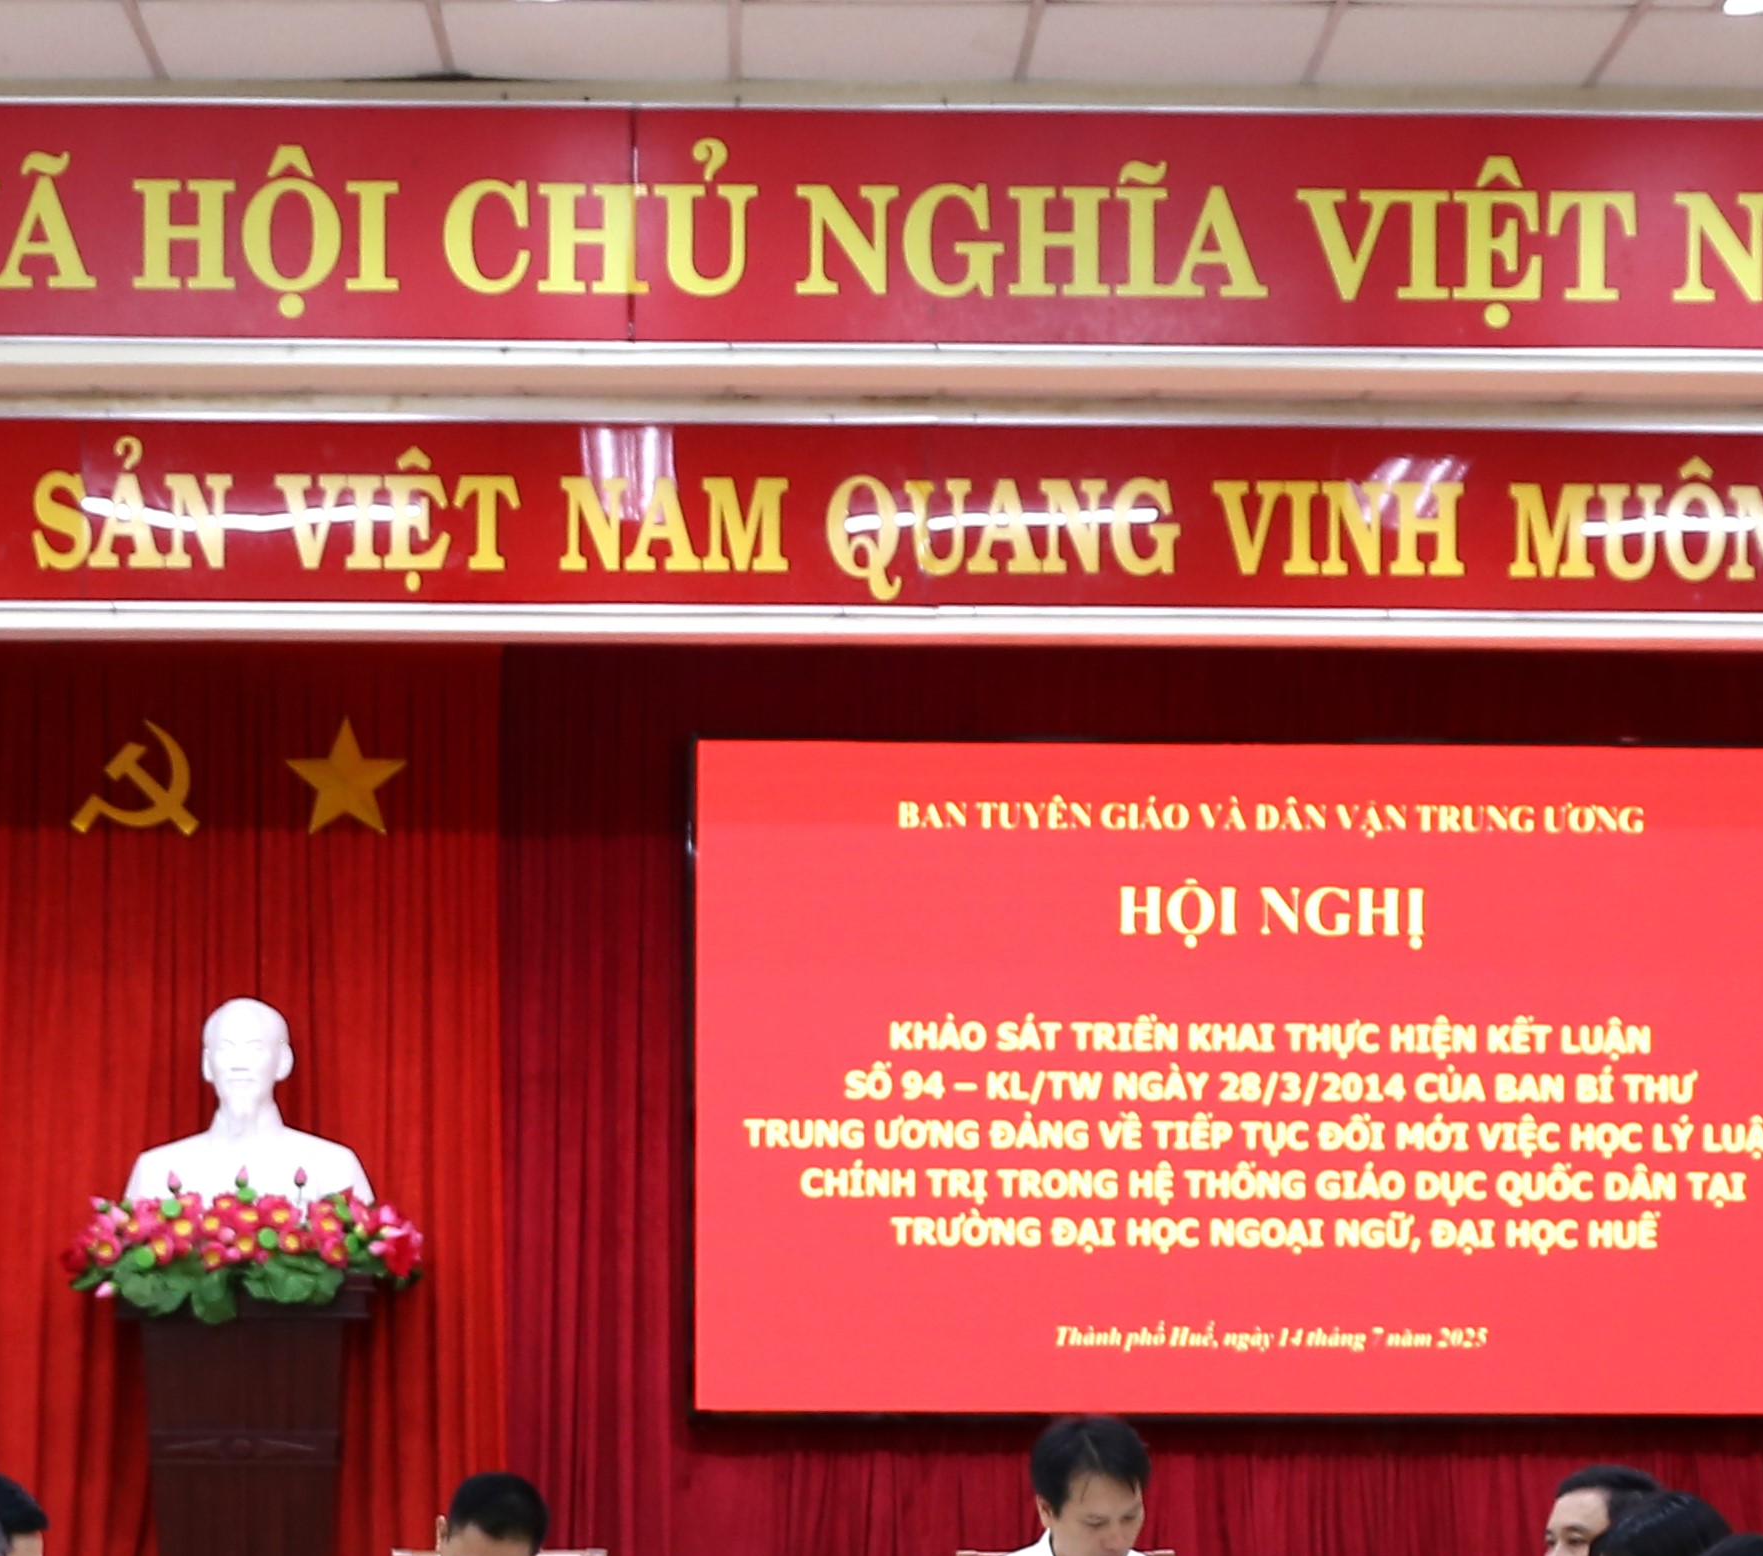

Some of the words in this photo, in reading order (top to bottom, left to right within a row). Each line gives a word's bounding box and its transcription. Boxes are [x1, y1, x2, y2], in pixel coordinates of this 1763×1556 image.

[132, 146, 400, 319] HỘI
[443, 139, 759, 297] CHỦ
[795, 161, 1270, 300] NGHĨA
[1297, 156, 1638, 330] VIỆT
[33, 437, 233, 571] SẢN
[275, 448, 521, 593] VIỆT
[559, 475, 790, 573] NAM
[824, 475, 1182, 602] QUANG
[1212, 480, 1466, 578] VINH
[898, 800, 967, 830] BAN
[975, 794, 1092, 830] TUYÊN
[1099, 794, 1190, 831] GIÁO
[1198, 795, 1247, 831] VÀ
[1255, 796, 1327, 832] DÂN
[1415, 803, 1535, 833] TRUNG
[1543, 801, 1644, 834] ƯƠNG
[1119, 877, 1237, 949] HỘI
[1259, 885, 1425, 951] NGHỊ
[889, 1012, 987, 1051] KHẢO
[996, 1012, 1062, 1051] SÁT
[1188, 1023, 1275, 1053] KHAI
[1285, 1018, 1380, 1060] THỰC
[1390, 1015, 1477, 1060] HIỆN
[1487, 1015, 1553, 1054] KẾT
[1560, 1016, 1652, 1061] LUẬN
[844, 1061, 893, 1100] SỐ
[901, 1070, 945, 1100] 94
[986, 1070, 1103, 1105] KL/TW
[1113, 1062, 1210, 1101] NGÀY
[1219, 1071, 1406, 1106] 28/3/2014
[1414, 1064, 1486, 1102] CỦA
[1494, 1073, 1565, 1102] BAN
[1575, 1065, 1614, 1103] BÍ
[1622, 1070, 1699, 1103] THƯ
[743, 1119, 865, 1148] TRUNG
[874, 1115, 980, 1149] ƯƠNG
[988, 1111, 1090, 1149] ĐẢNG
[1098, 1111, 1143, 1150] VỀ
[1152, 1111, 1233, 1150] TIẾP
[1241, 1120, 1310, 1157] TỤC
[1318, 1112, 1385, 1151] ĐỔI
[1395, 1112, 1469, 1151] MỚI
[1477, 1113, 1561, 1158] VIỆC
[1570, 1122, 1643, 1159] HỌC
[1652, 1114, 1695, 1152] LÝ
[800, 1158, 916, 1198] CHÍNH
[925, 1168, 988, 1205] TRỊ
[996, 1168, 1119, 1199] TRONG
[1128, 1160, 1174, 1206] HỆ
[1184, 1161, 1307, 1200] THỐNG
[1315, 1161, 1406, 1200] GIÁO
[1415, 1171, 1487, 1207] DỤC
[1496, 1162, 1594, 1208] QUỐC
[1604, 1162, 1677, 1201] DÂN
[1686, 1172, 1748, 1208] TẠI
[890, 1208, 1042, 1247] TRƯỜNG
[1050, 1216, 1116, 1254] ĐẠI
[1126, 1217, 1200, 1255] HỌC
[1209, 1218, 1325, 1255] NGOẠI
[1335, 1211, 1422, 1253] NGỮ,
[1429, 1219, 1495, 1255] ĐẠI
[1505, 1219, 1579, 1256] HỌC
[1588, 1210, 1661, 1249] HUẾ
[1055, 1325, 1122, 1347] Thành
[1123, 1320, 1167, 1352] phố
[1169, 1320, 1219, 1348] Huế,
[1224, 1325, 1274, 1352] ngày
[1279, 1327, 1303, 1347] 14
[1307, 1326, 1367, 1352] tháng
[1386, 1327, 1433, 1348] năm
[1437, 1326, 1489, 1348] 2025
